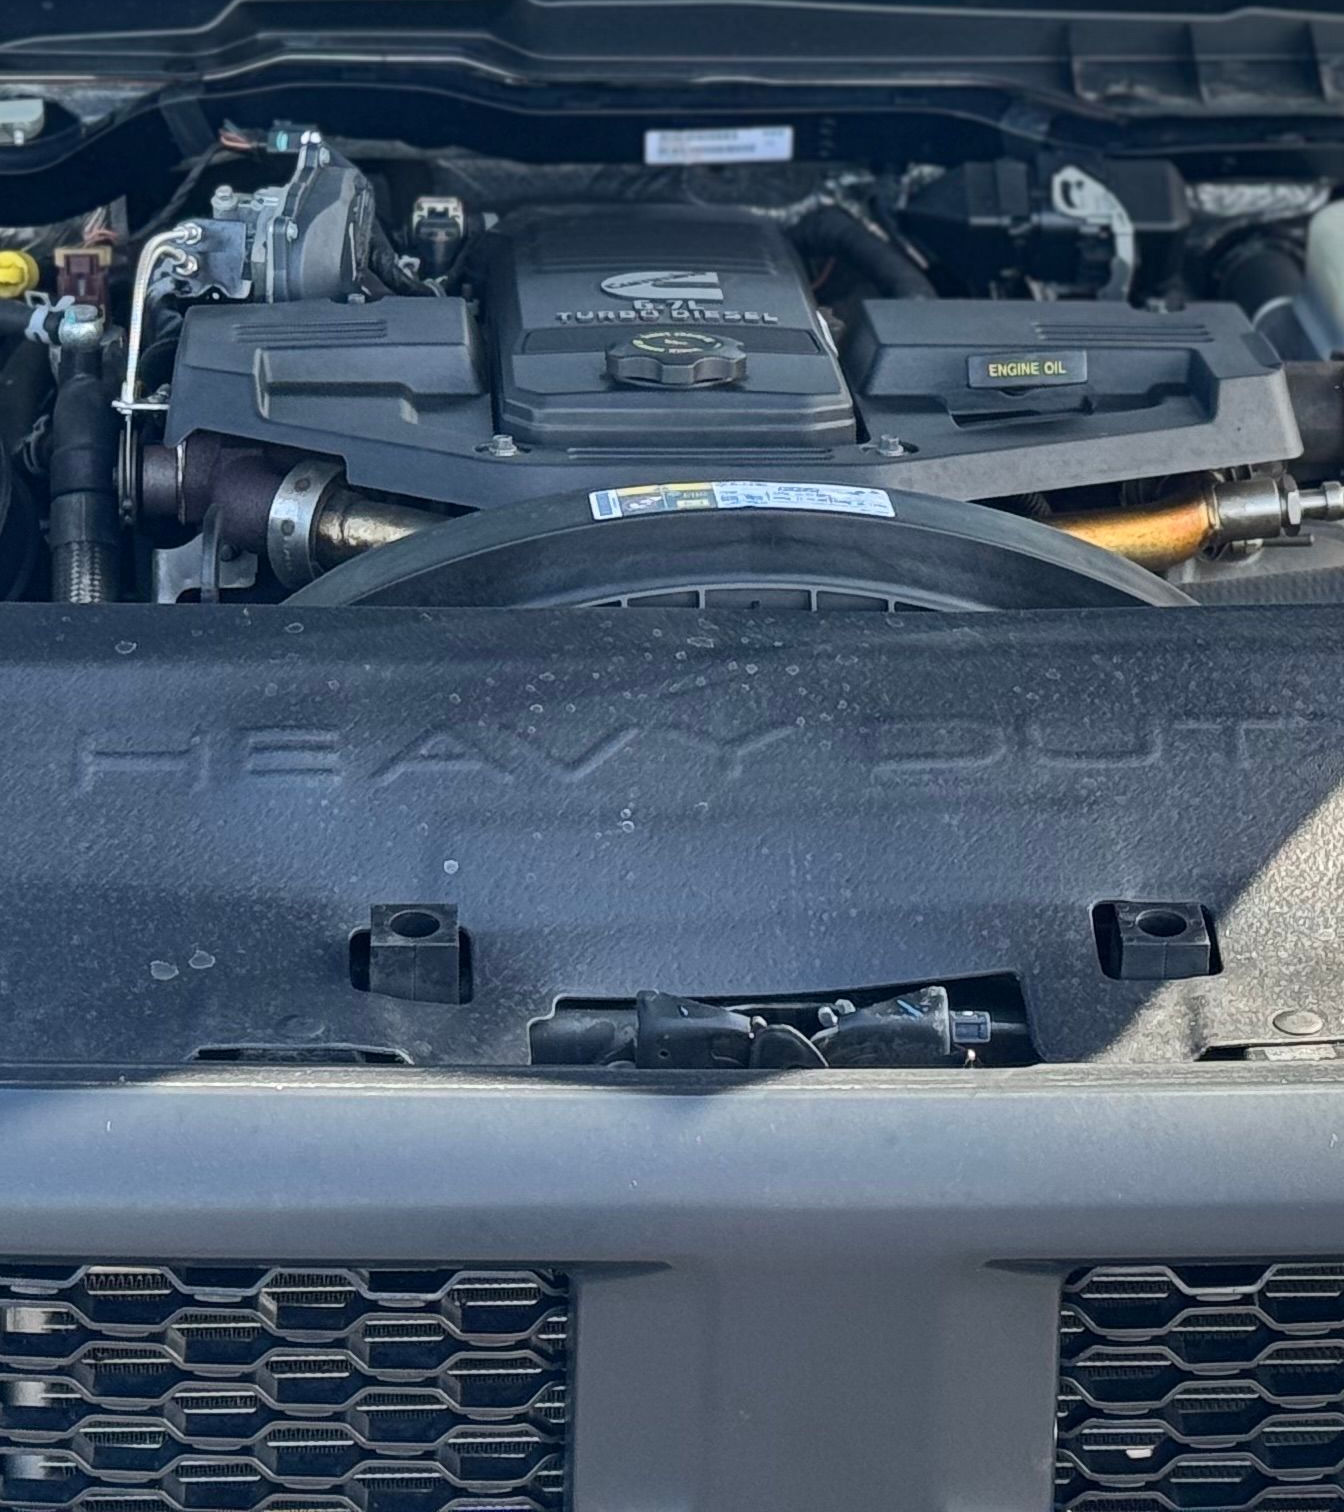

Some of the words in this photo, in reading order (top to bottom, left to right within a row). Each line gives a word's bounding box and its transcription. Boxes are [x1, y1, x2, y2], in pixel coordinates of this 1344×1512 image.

[633, 299, 705, 311] 6.7L
[556, 309, 660, 323] TURBO
[670, 310, 779, 324] DIESEL
[988, 361, 1040, 377] ENGINE
[1044, 360, 1067, 375] OIL
[69, 719, 798, 791] HEAVY
